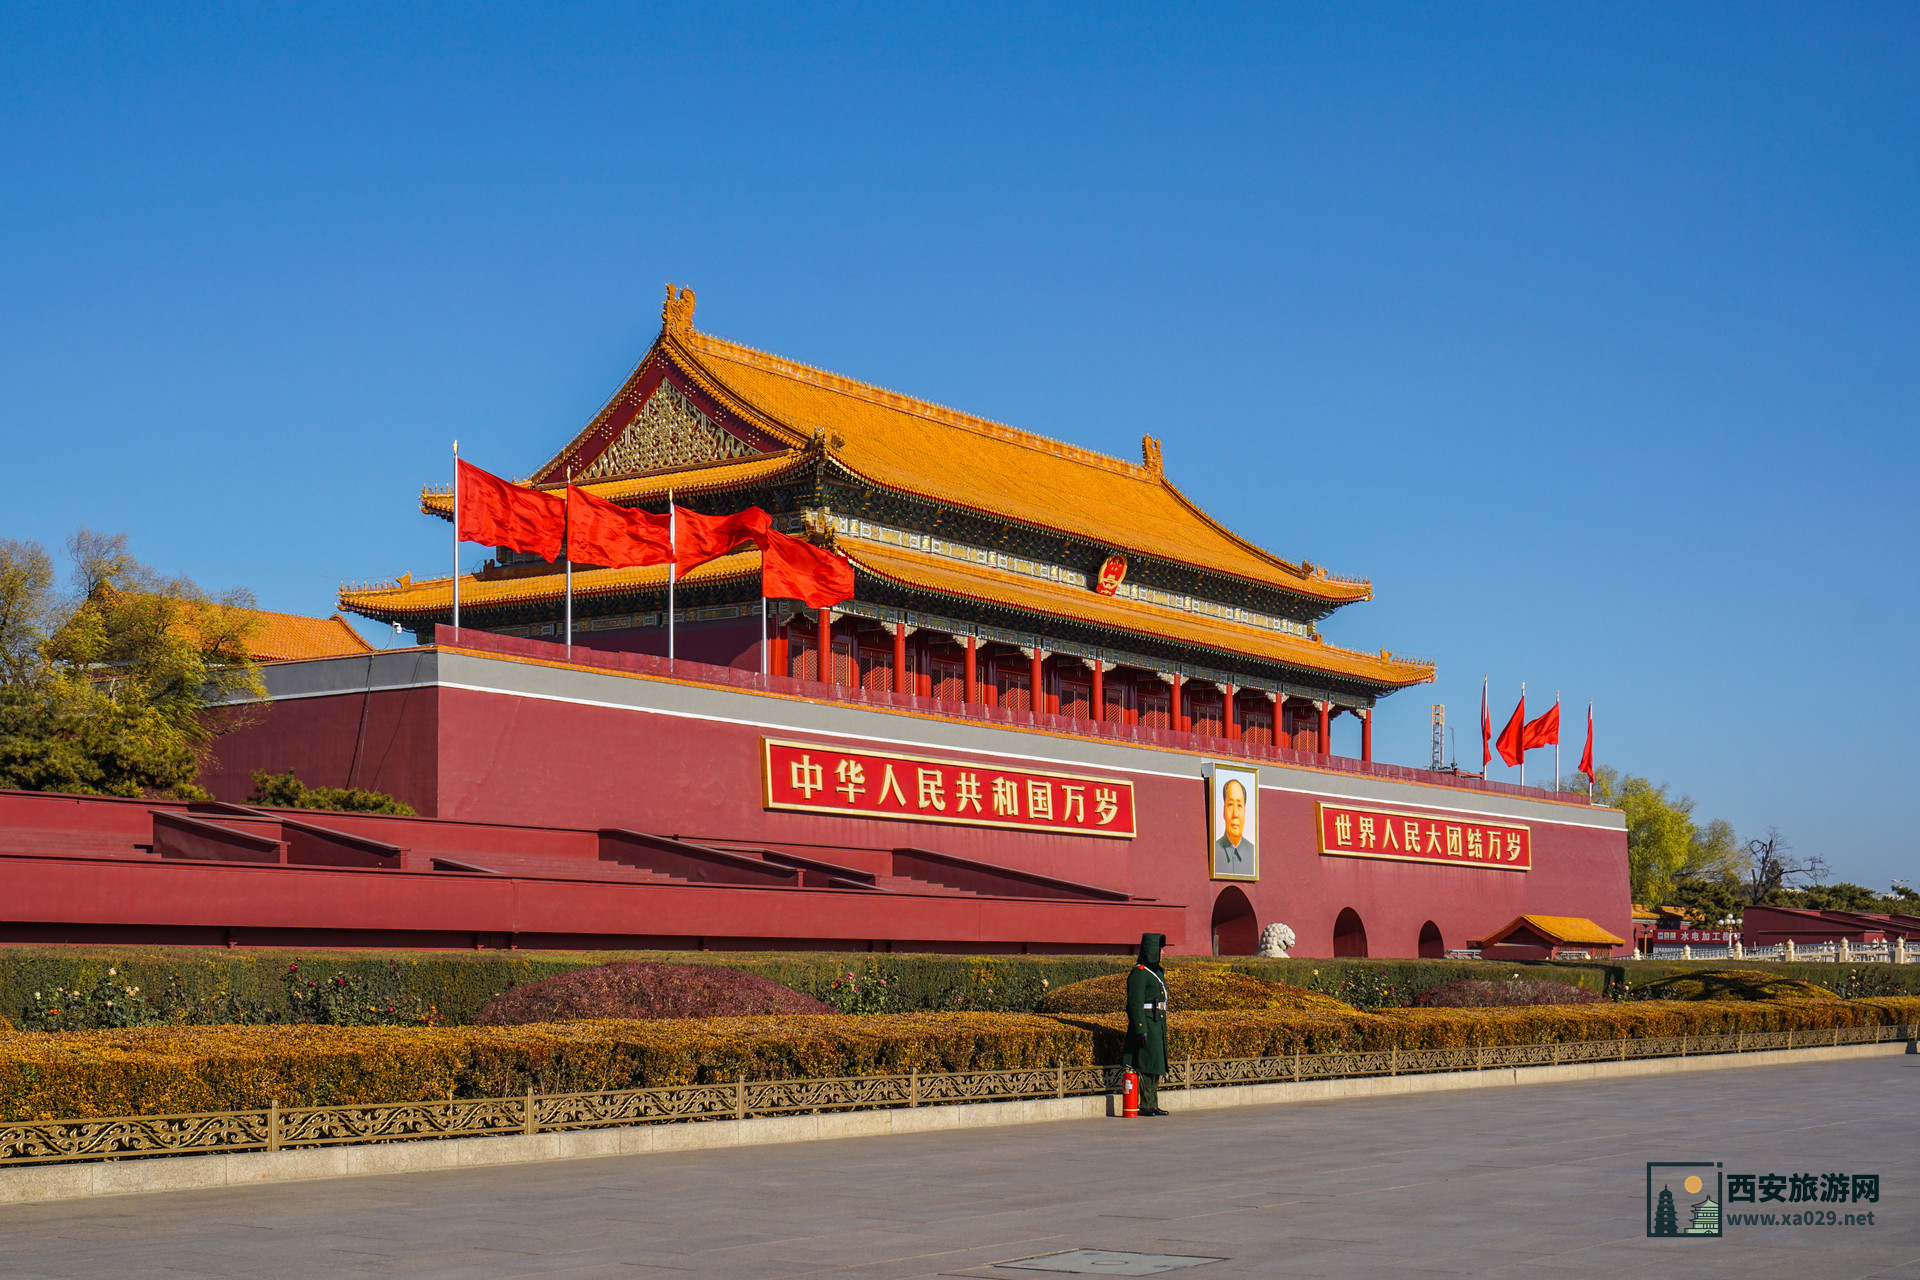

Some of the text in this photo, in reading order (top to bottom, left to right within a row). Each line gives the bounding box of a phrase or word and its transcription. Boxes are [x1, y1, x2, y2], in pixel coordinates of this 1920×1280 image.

[790, 754, 1119, 826] 中华人民共和国万岁
[1334, 813, 1521, 862] 世界人民大团结万岁
